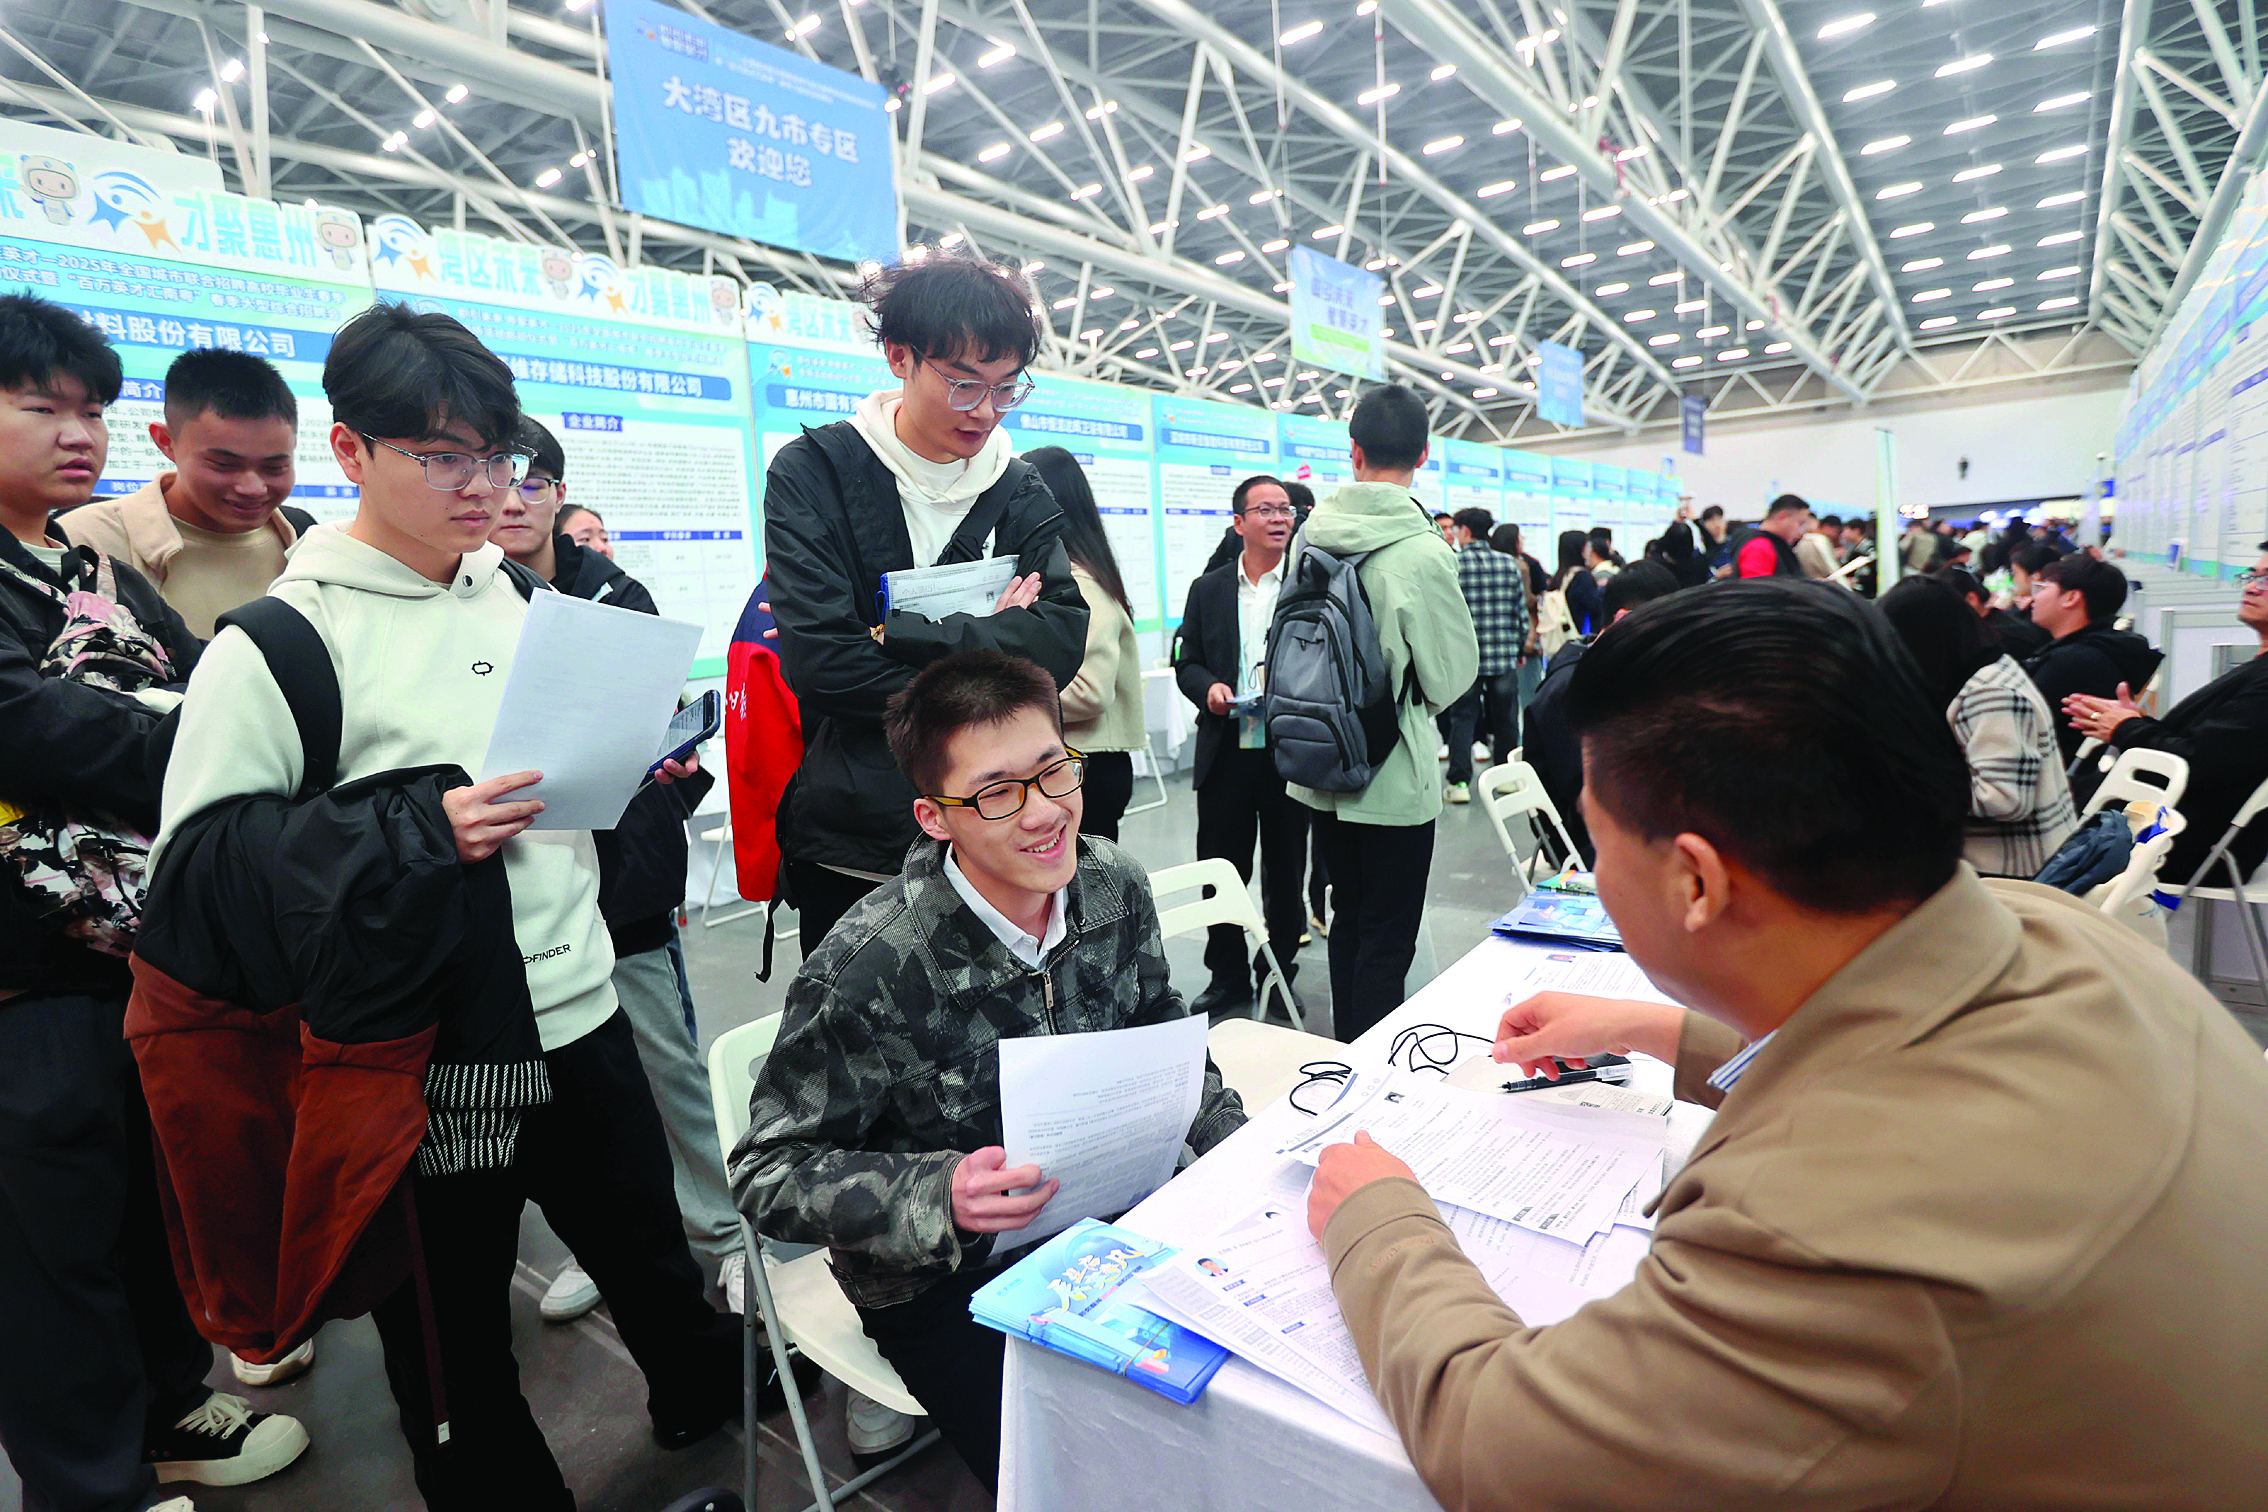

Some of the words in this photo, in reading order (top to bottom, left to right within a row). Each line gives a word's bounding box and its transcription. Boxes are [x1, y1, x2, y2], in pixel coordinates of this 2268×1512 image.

[661, 75, 860, 165] 大湾区九市专区
[726, 137, 813, 188] 欢迎您
[174, 192, 318, 268] 才聚惠州
[0, 265, 60, 287] 仪式暨
[435, 227, 543, 297] 湾区未来
[627, 270, 712, 325] 才聚惠州
[81, 310, 297, 358] 料股份有限公司
